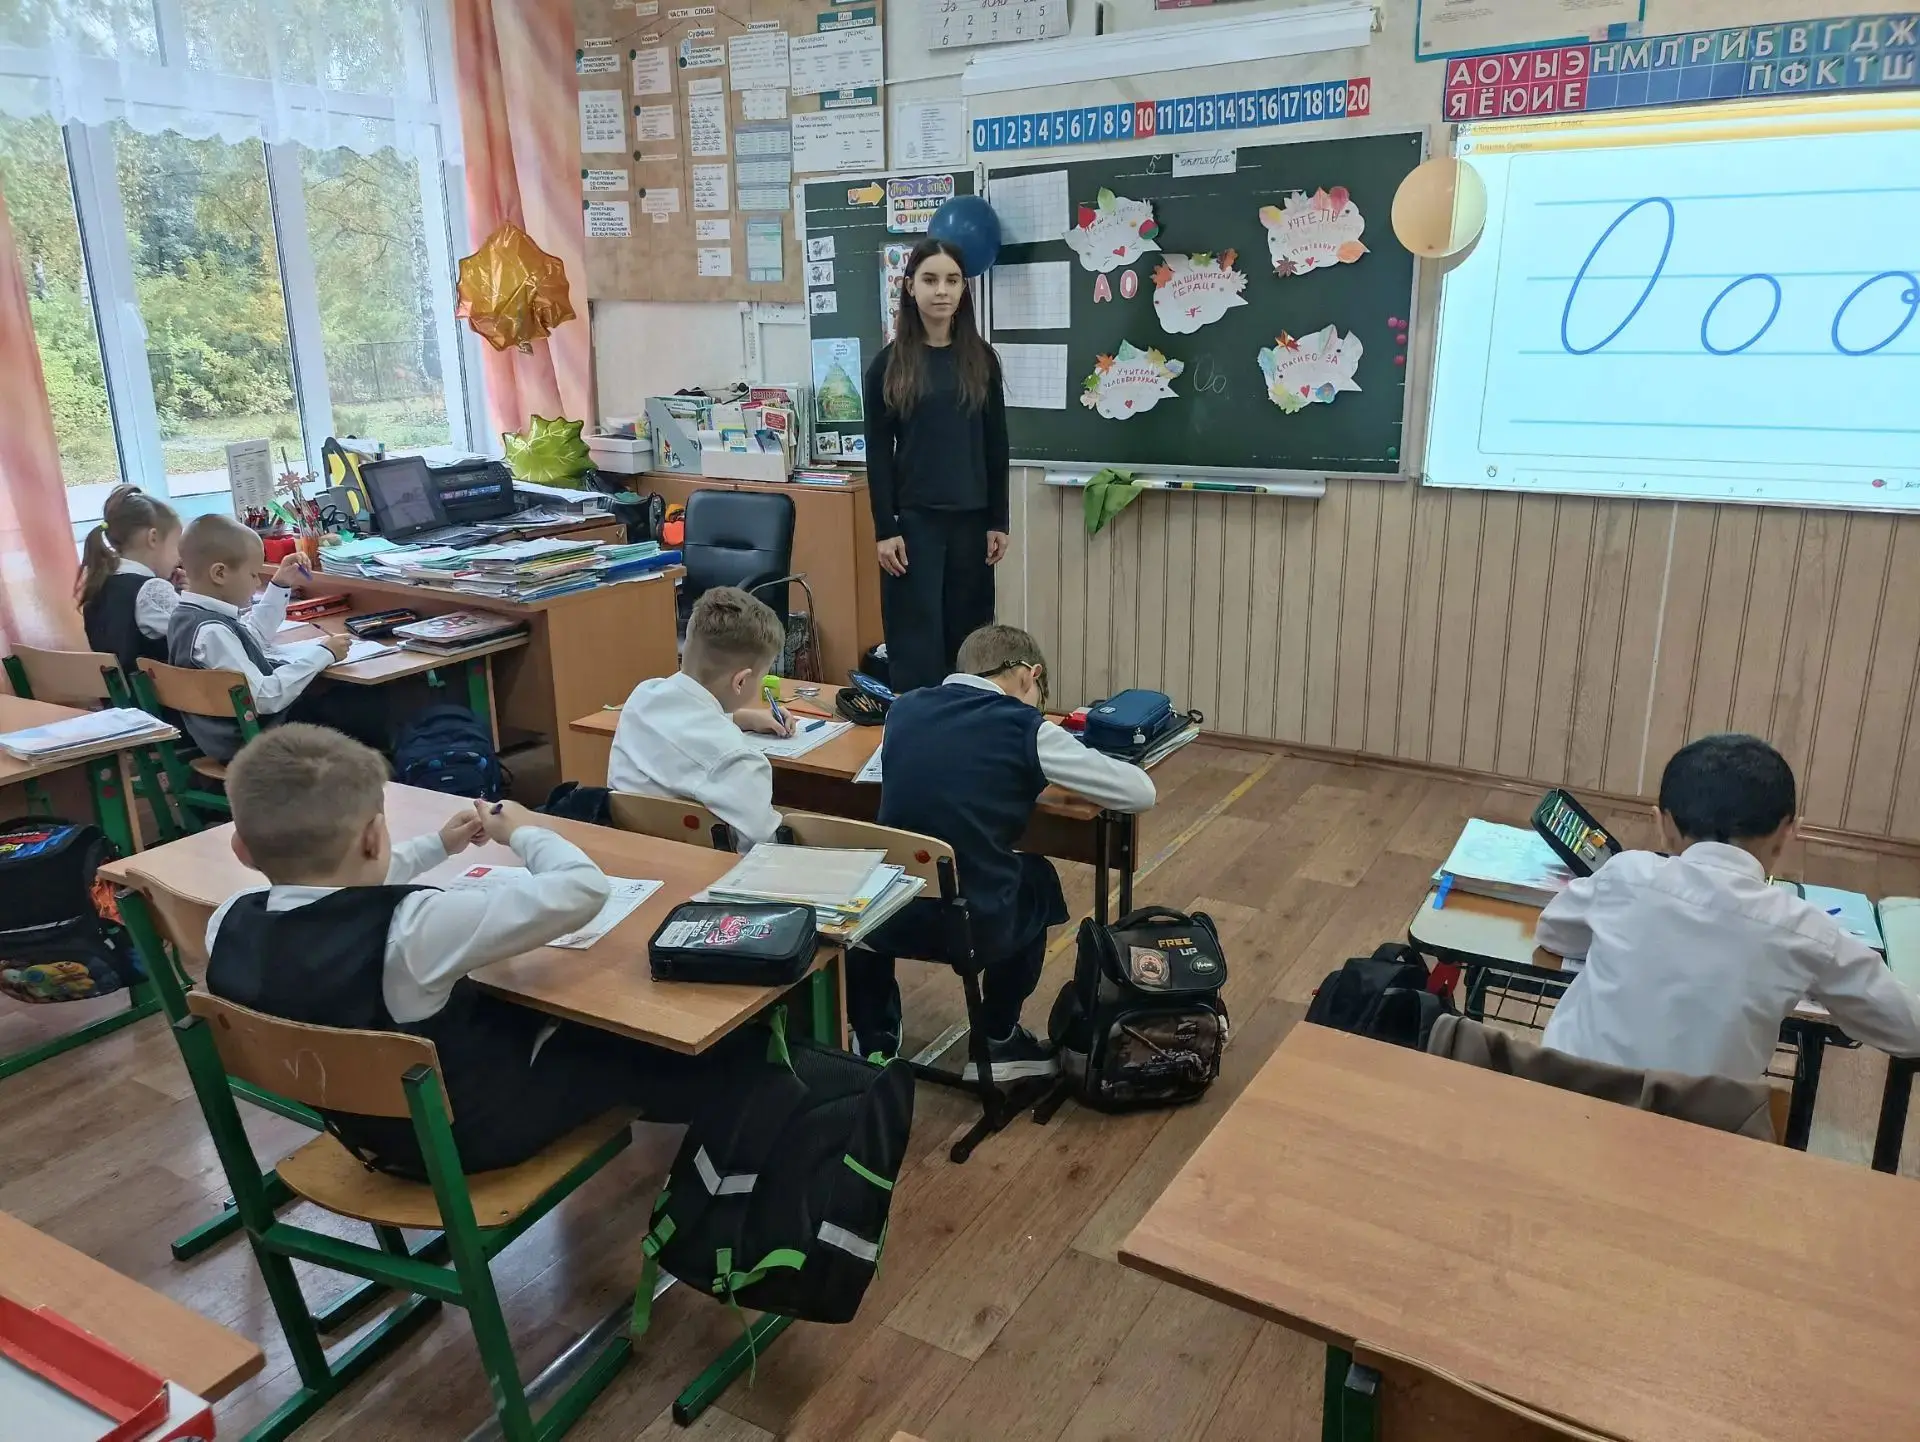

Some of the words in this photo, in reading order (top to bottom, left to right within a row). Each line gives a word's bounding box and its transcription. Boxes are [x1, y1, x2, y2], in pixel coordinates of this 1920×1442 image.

[670, 10, 688, 18] ЧАСТИ
[695, 7, 714, 15] СЛОВА
[968, 15, 973, 26] 2
[991, 12, 998, 23] 3
[1016, 8, 1022, 20] 4
[1039, 5, 1045, 16] 5
[688, 30, 714, 38] Суффикс
[942, 35, 949, 46] 6
[1039, 24, 1045, 35] 0
[1450, 63, 1472, 86] А
[1478, 60, 1500, 84] О
[1506, 56, 1527, 80] У
[1535, 53, 1558, 78] Ы
[1565, 51, 1585, 76] Э
[1594, 48, 1614, 73] Н
[1620, 44, 1648, 71] М
[1655, 41, 1677, 67] Л
[1692, 38, 1710, 63] Р
[1721, 31, 1745, 60] Й
[1755, 31, 1773, 57] Б
[1789, 28, 1806, 53] В
[1824, 23, 1847, 50] Г
[1851, 21, 1878, 53] Д
[1886, 20, 1916, 47] Ж
[1450, 93, 1467, 116] Я
[1479, 88, 1494, 114] Ё
[1503, 89, 1527, 113] Ю
[1532, 85, 1553, 110] И
[1564, 83, 1580, 107] Е
[1749, 65, 1771, 90] П
[1780, 62, 1807, 86] Ф
[1816, 59, 1840, 85] К
[1854, 56, 1875, 82] Т
[1882, 56, 1912, 80] Ш
[977, 125, 985, 146] 0
[993, 123, 999, 145] 1
[1007, 122, 1015, 144] 2
[1023, 120, 1031, 142] 3
[1039, 118, 1048, 140] 4
[1055, 117, 1063, 140] 5
[1071, 115, 1080, 137] 6
[1088, 113, 1096, 136] 7
[1104, 111, 1113, 134] 8
[1121, 110, 1130, 132] 9
[1137, 107, 1153, 131] 10
[1158, 106, 1172, 129] 11
[1177, 104, 1193, 127] 12
[1198, 102, 1213, 126] 13
[1218, 100, 1235, 123] 14
[1239, 97, 1255, 122] 15
[1259, 95, 1277, 120] 16
[1282, 92, 1299, 117] 17
[1304, 90, 1322, 115] 18
[1327, 87, 1345, 113] 19
[1348, 85, 1368, 111] 20
[1180, 150, 1231, 168] октября
[1094, 273, 1112, 303] А
[1120, 270, 1138, 299] О
[1326, 354, 1338, 365] ЗА
[1158, 937, 1193, 949] FREE
[1179, 947, 1198, 956] UP
